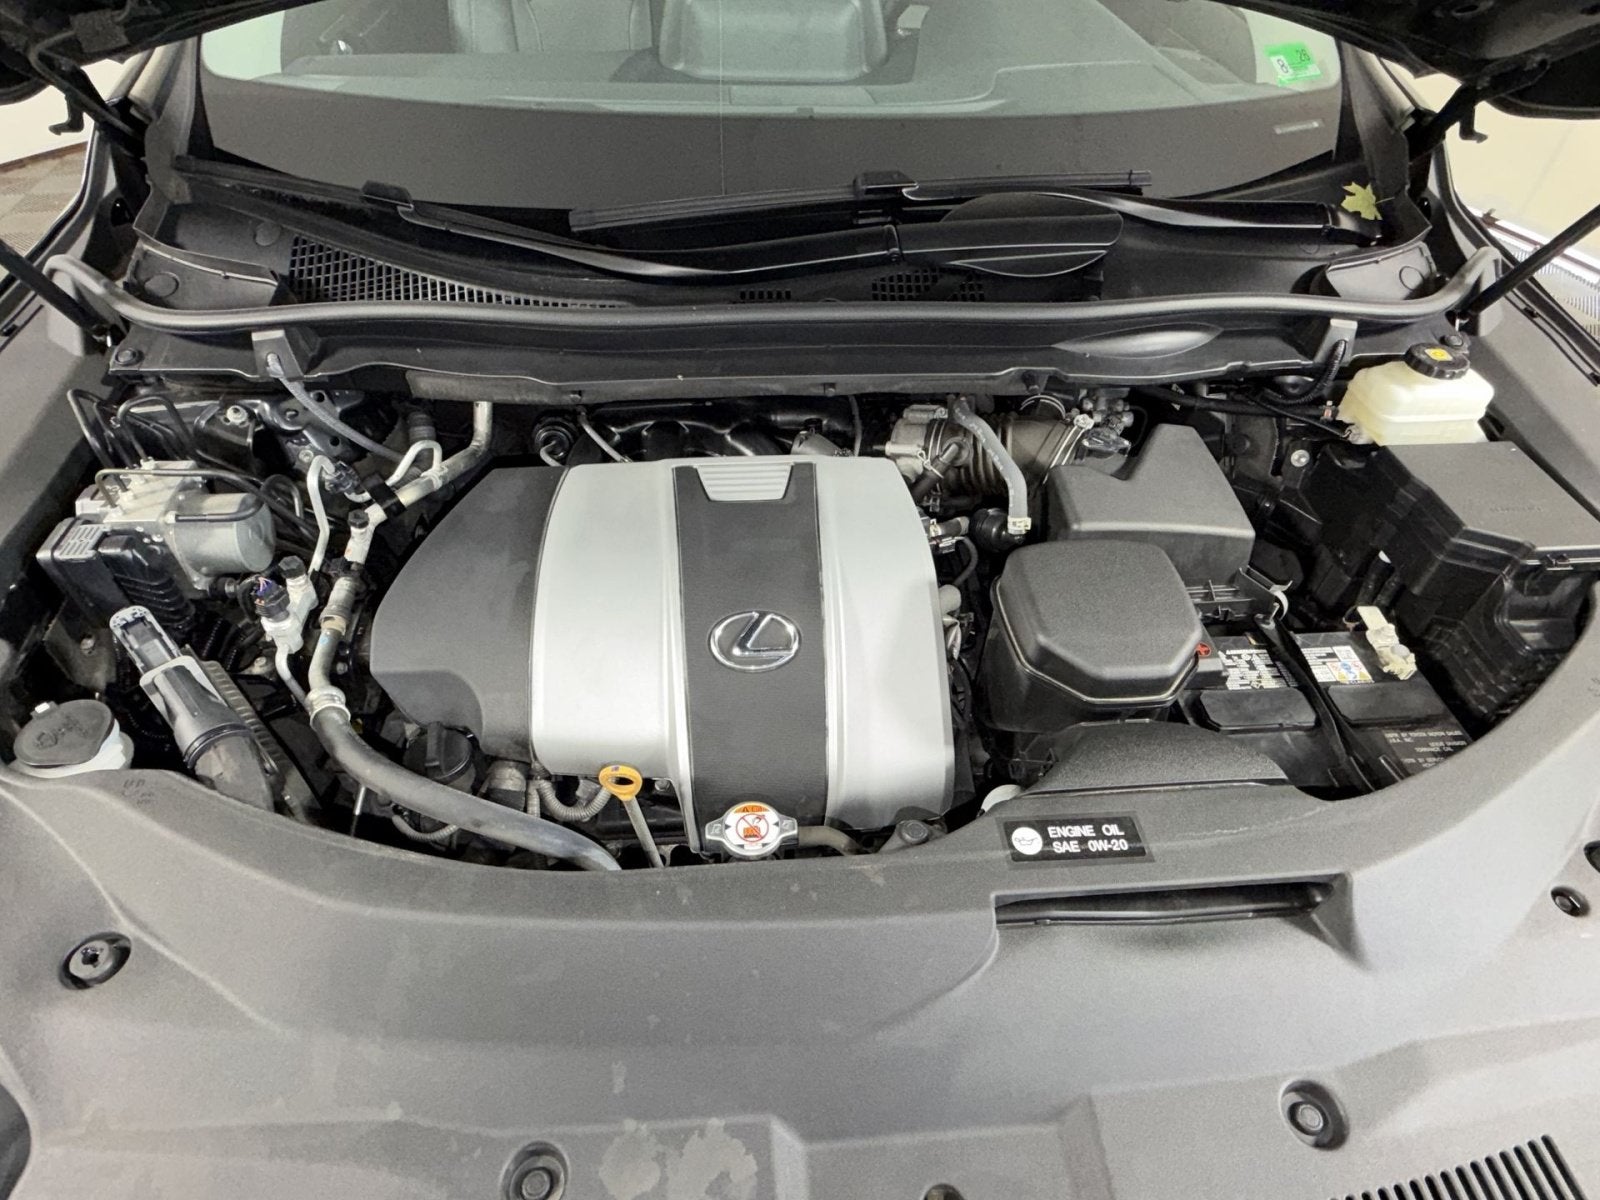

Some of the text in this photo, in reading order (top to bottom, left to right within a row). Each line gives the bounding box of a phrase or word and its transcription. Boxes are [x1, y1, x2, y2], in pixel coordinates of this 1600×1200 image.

[1047, 824, 1125, 838] ENGINE OIL
[1052, 839, 1129, 853] SAE 0W-20
